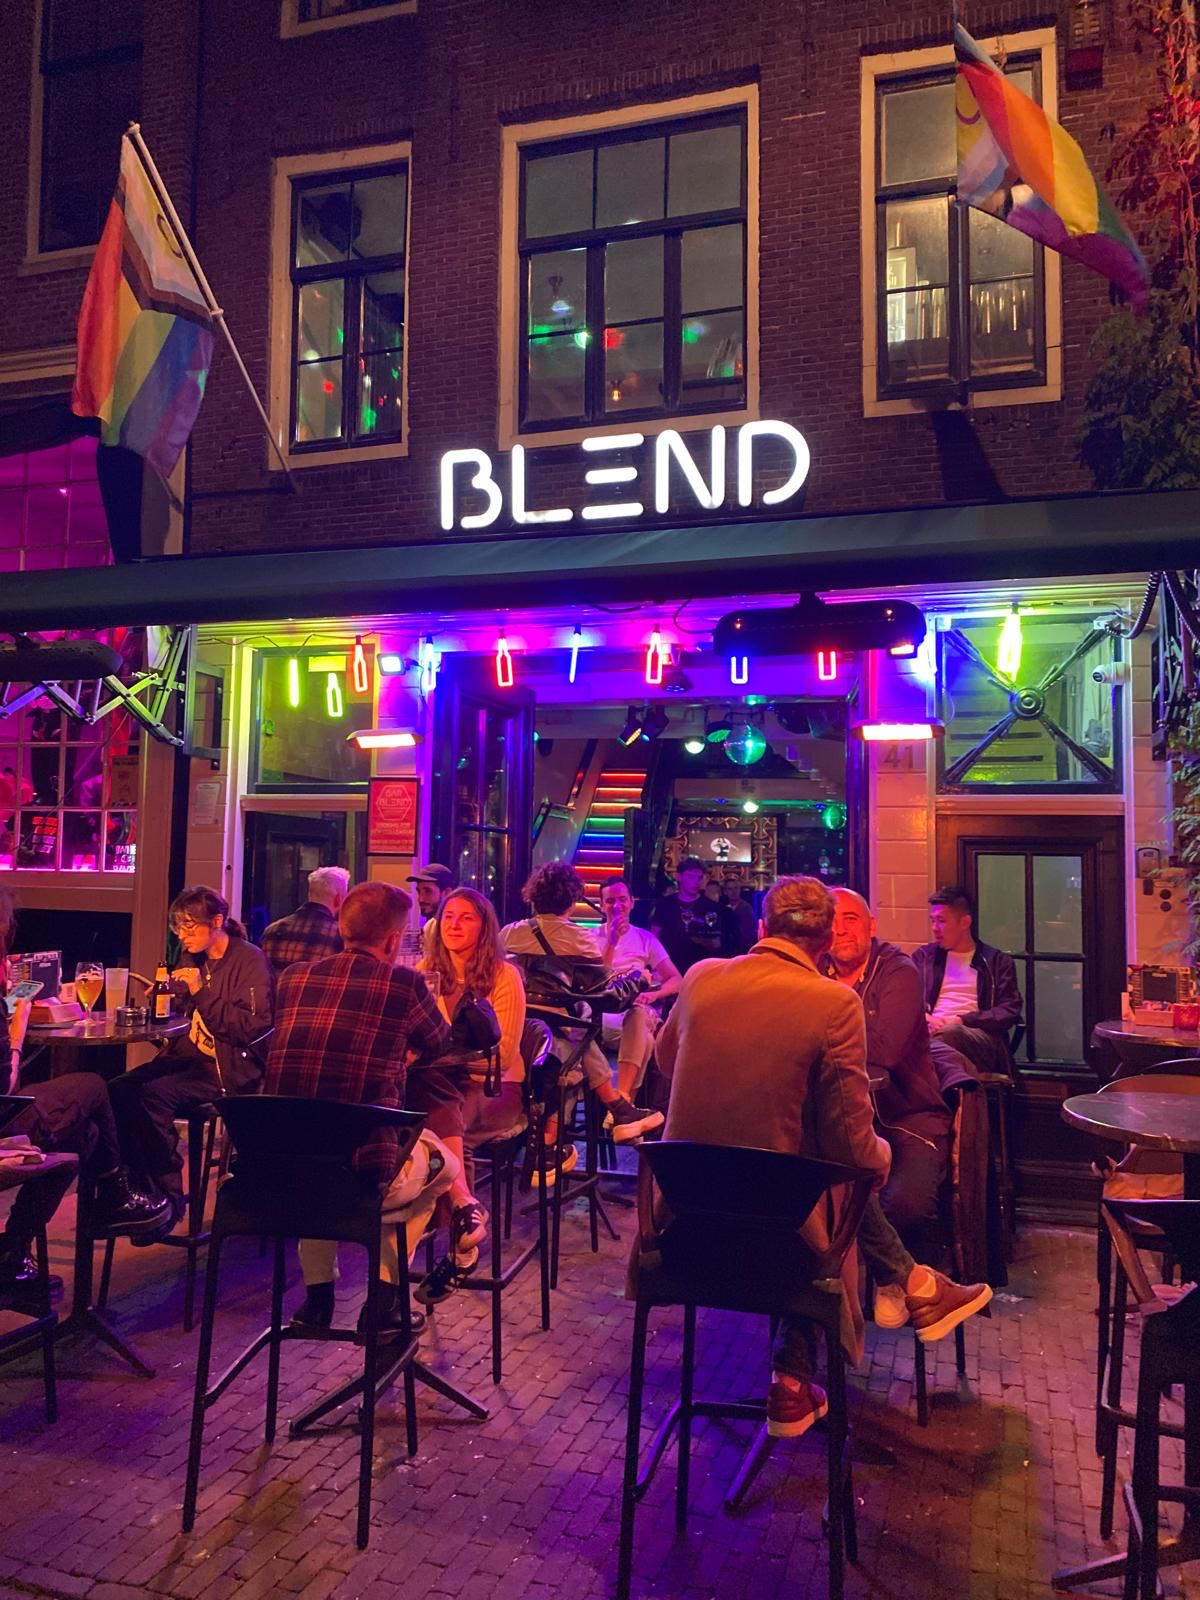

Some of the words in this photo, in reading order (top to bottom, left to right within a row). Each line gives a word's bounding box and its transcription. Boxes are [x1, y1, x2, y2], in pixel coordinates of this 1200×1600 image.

[440, 419, 811, 530] BLEND
[884, 745, 914, 769] 41
[385, 789, 402, 797] BAR
[379, 798, 409, 806] BLEND
